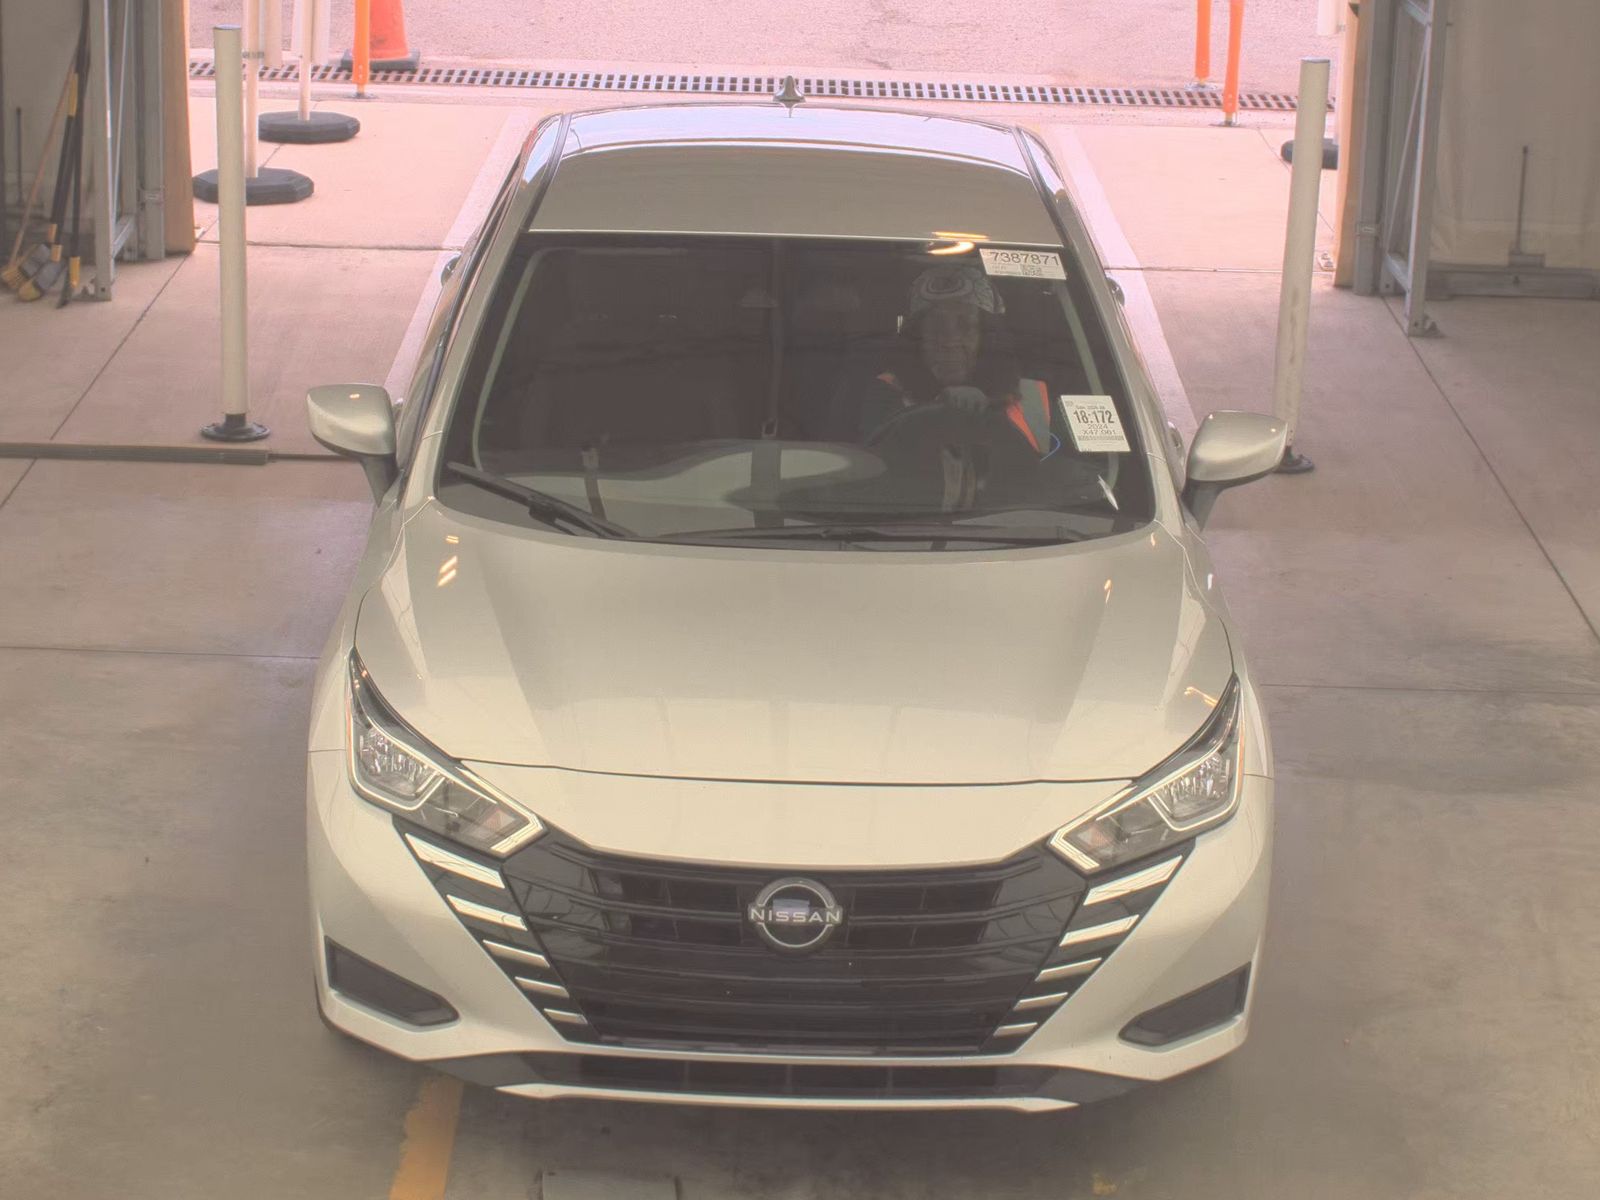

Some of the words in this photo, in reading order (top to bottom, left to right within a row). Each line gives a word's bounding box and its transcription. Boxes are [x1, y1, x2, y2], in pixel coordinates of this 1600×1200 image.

[990, 251, 1060, 266] 7387871
[1073, 410, 1115, 424] 18:172
[751, 908, 840, 922] NISSAN
